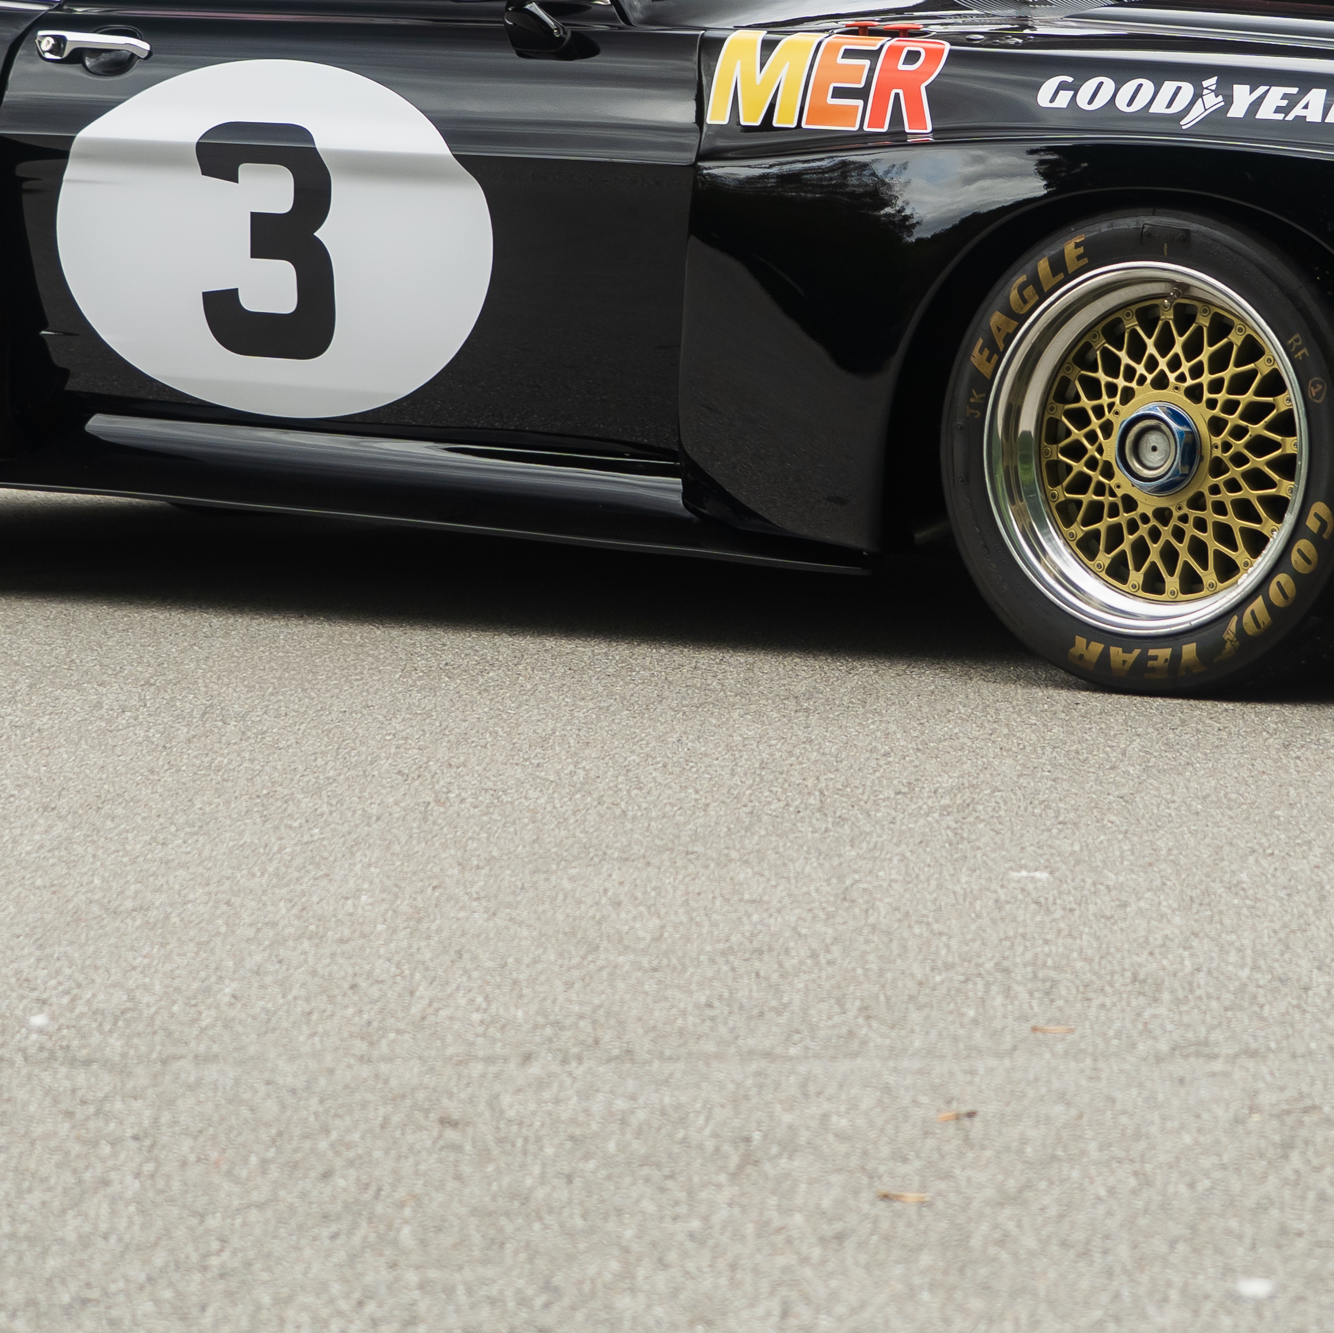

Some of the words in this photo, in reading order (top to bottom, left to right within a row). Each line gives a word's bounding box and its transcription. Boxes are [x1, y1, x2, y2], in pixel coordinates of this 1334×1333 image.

[706, 30, 951, 134] MER
[195, 121, 337, 361] 3
[970, 233, 1090, 381] EAGLE
